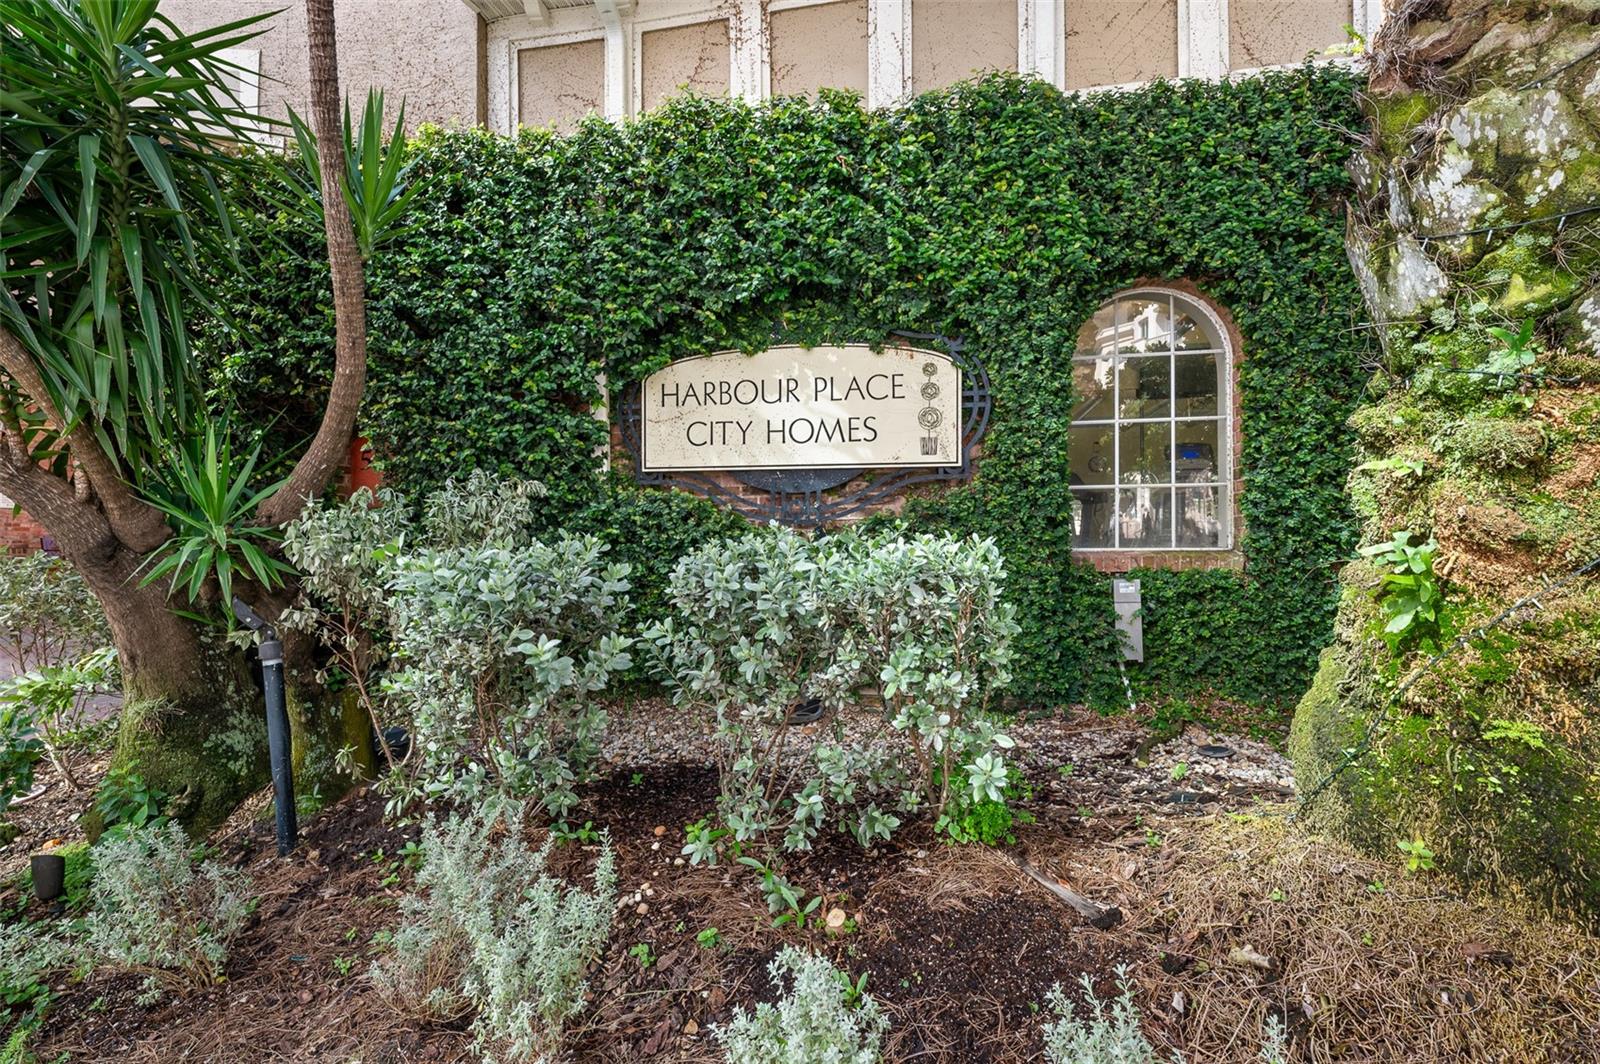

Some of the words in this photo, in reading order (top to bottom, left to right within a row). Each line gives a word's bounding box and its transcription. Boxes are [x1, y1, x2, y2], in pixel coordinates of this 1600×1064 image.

[660, 377, 801, 408] HARBOUR
[814, 373, 906, 402] PLACE
[686, 420, 753, 447] CITY
[766, 416, 878, 444] HOMES
